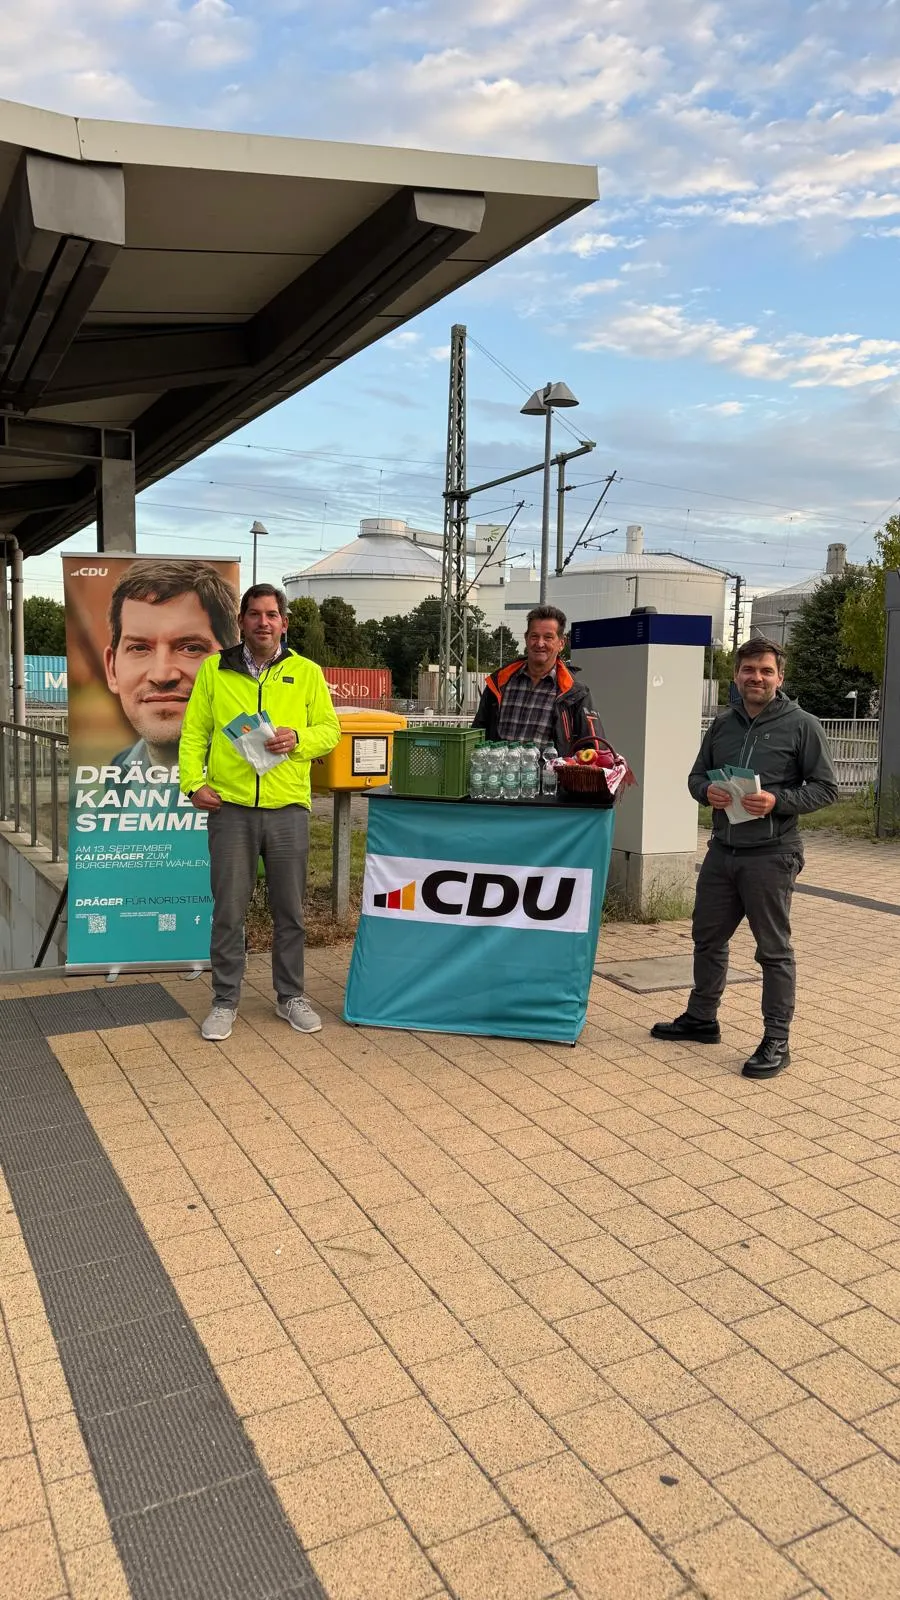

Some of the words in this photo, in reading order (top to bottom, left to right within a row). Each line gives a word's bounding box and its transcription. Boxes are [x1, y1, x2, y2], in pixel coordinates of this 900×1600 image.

[80, 567, 108, 577] CDU
[341, 682, 370, 698] SÜD
[75, 760, 207, 784] DRÄGE
[75, 789, 171, 807] KANN
[75, 812, 209, 832] STEMME
[75, 845, 91, 853] AM
[109, 844, 172, 853] SEPTEMBER
[75, 853, 95, 861] KAI
[97, 851, 144, 861] DRÄGER
[146, 852, 169, 860] ZUM
[75, 861, 163, 869] BÜRGERMEISTER
[75, 896, 124, 907] DRÄGER
[149, 896, 214, 905] NORDSTEMM
[421, 869, 576, 921] CDU
